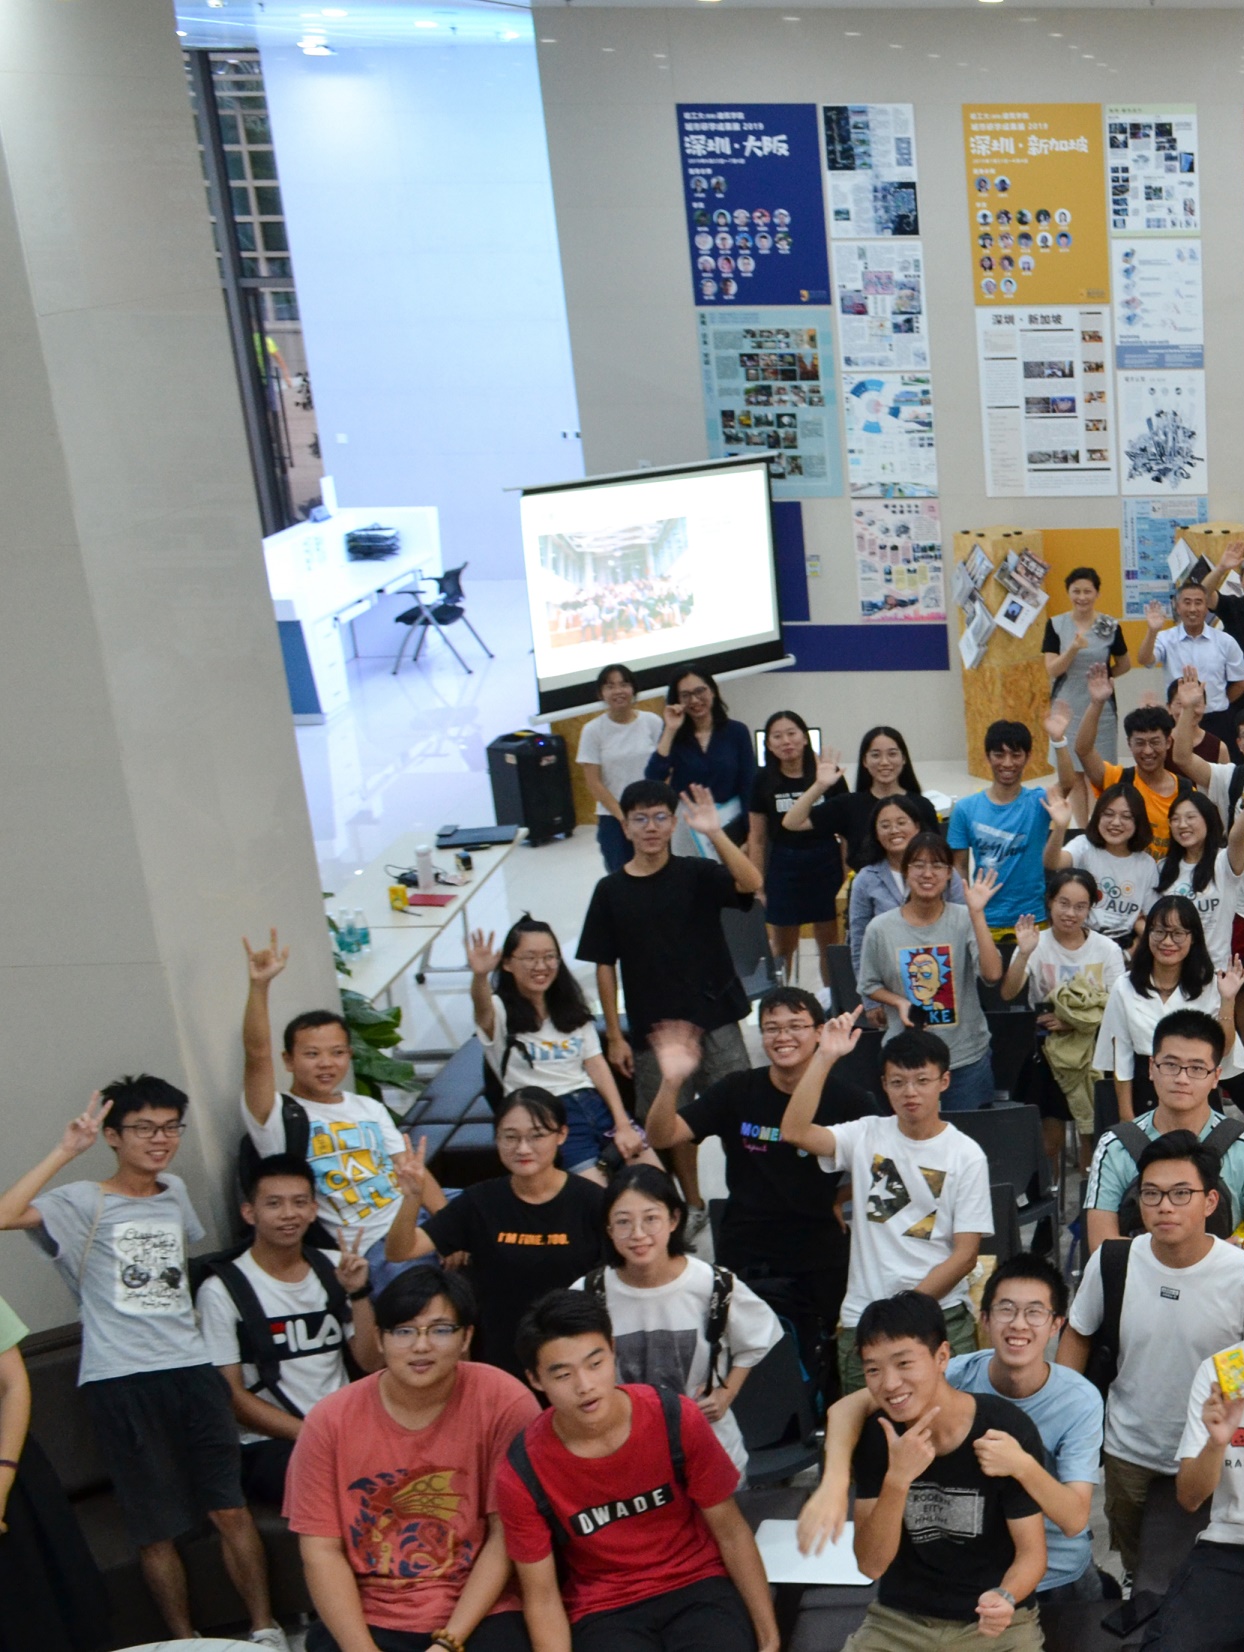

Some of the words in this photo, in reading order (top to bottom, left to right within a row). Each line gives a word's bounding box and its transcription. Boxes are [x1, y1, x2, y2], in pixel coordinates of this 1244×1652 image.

[1105, 900, 1139, 915] AUP
[1198, 898, 1220, 913] UP
[740, 1122, 783, 1142] MOME
[270, 1313, 343, 1351] FILA
[578, 1488, 667, 1534] DWADE
